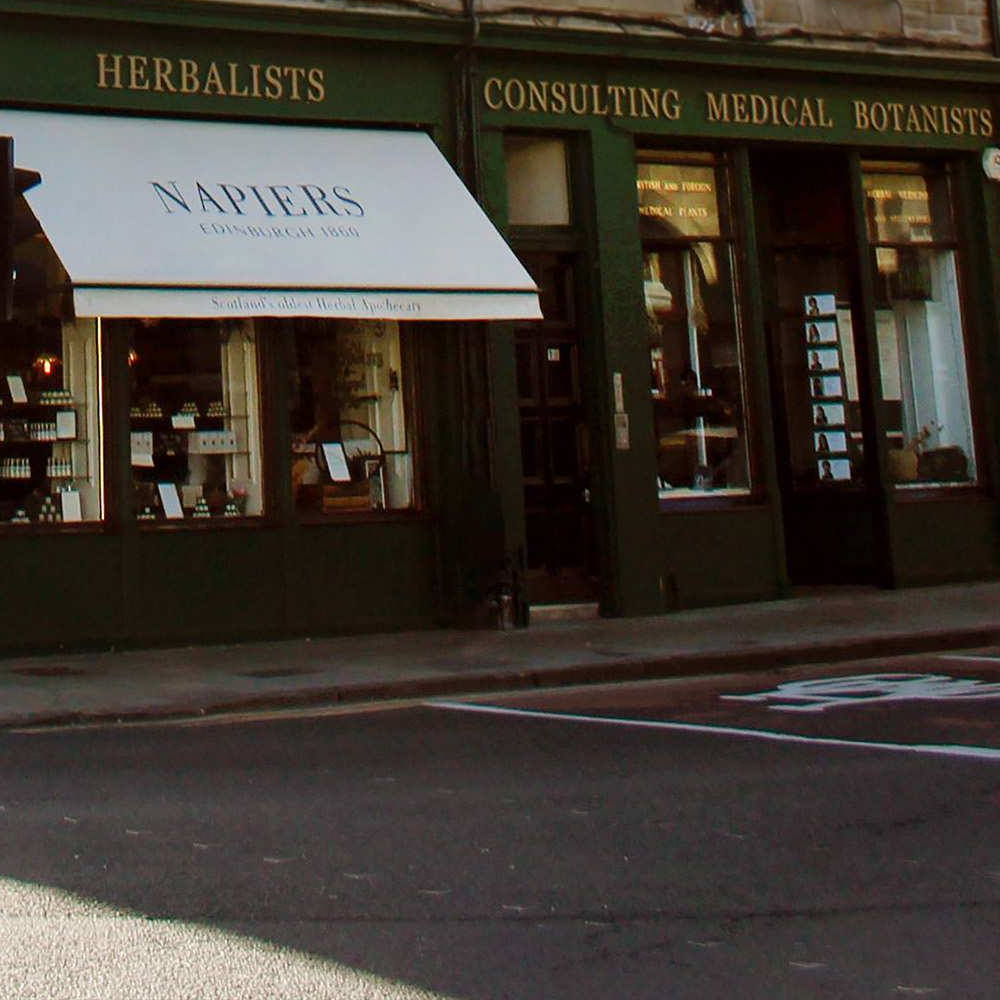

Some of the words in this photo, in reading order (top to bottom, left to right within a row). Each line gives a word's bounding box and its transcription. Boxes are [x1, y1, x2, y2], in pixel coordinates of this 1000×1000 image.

[96, 53, 326, 101] HERBALISTS
[484, 77, 682, 120] CONSULTING
[706, 91, 833, 128] MEDICAL
[854, 101, 993, 137] BOTANISTS
[148, 180, 365, 218] NAPIERS
[199, 223, 315, 239] EDINBURGH
[320, 226, 360, 239] 1860
